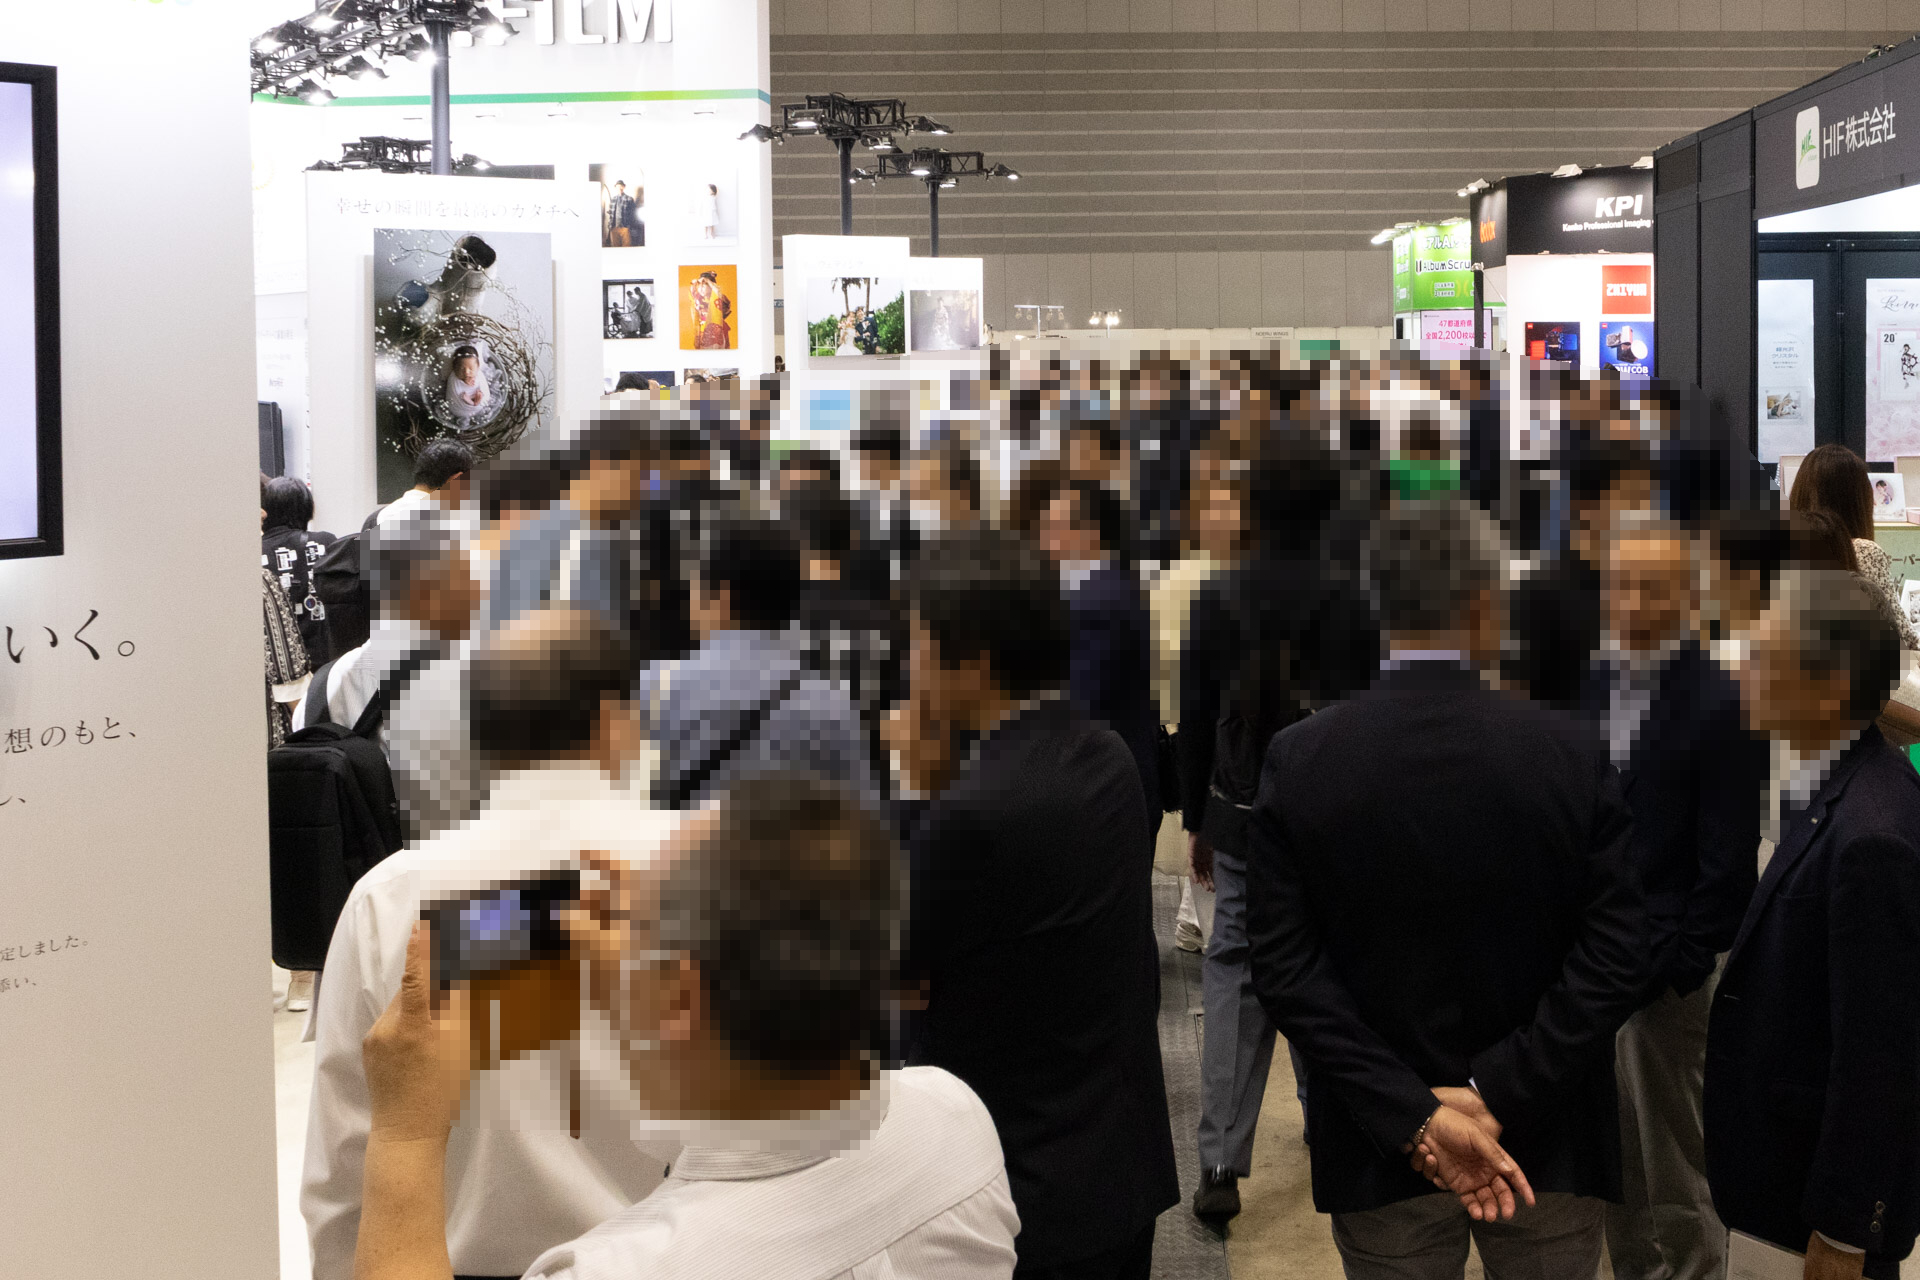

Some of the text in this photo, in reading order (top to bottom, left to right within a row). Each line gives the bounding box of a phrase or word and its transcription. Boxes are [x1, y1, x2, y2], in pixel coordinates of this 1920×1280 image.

[453, 0, 673, 47] FILM
[1823, 101, 1897, 159] HIF株式会社
[336, 197, 581, 219] 幸せの瞬間を最高のカタチへ
[1595, 194, 1644, 218] KPI
[1584, 219, 1624, 230] Professional
[1625, 218, 1652, 228] Imaging
[1883, 333, 1895, 343] 20
[5, 609, 135, 664] いく。
[4, 717, 136, 754] 想のもと、
